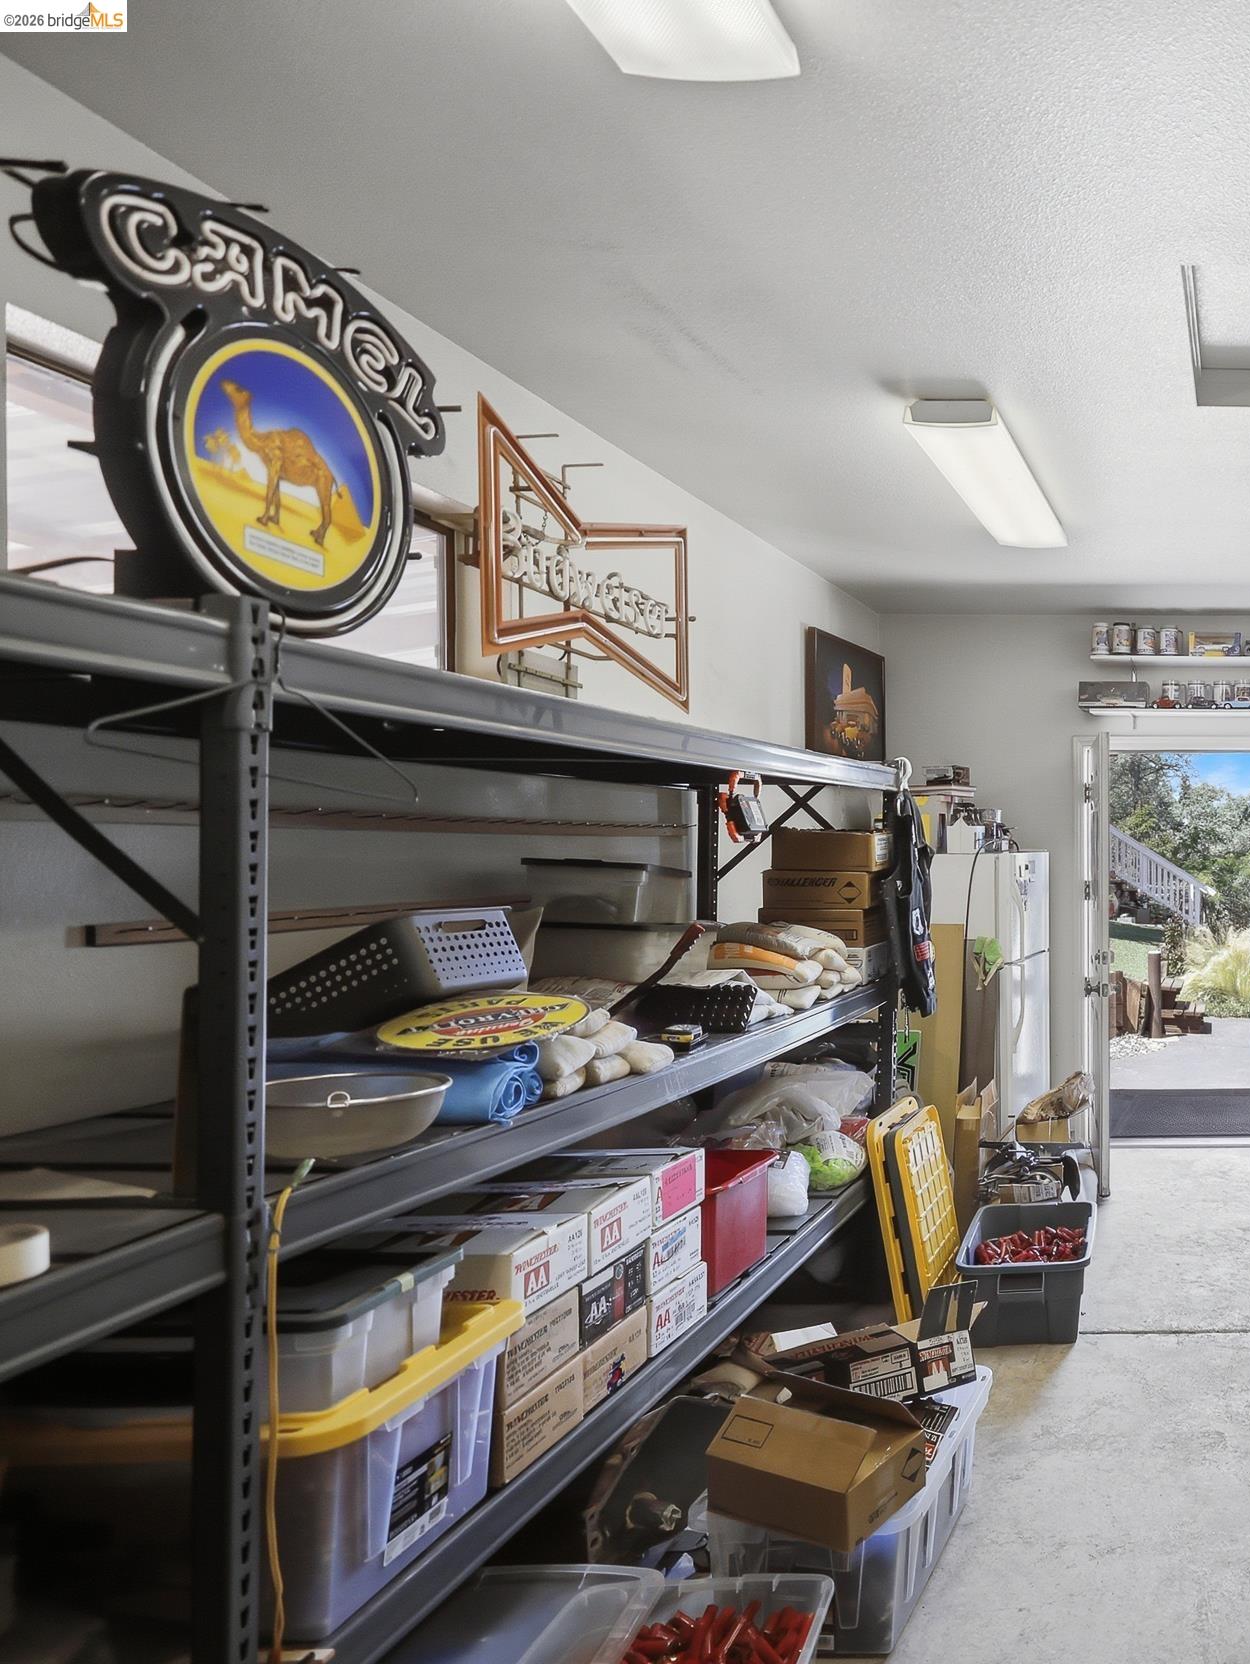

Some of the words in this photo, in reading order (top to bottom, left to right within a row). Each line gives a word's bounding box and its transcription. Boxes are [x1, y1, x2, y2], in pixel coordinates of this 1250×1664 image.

[100, 192, 436, 441] CAMEL
[767, 877, 838, 888] CHALLENGER
[426, 1034, 500, 1048] USE
[525, 1266, 549, 1299] AA
[655, 1307, 671, 1333] AA
